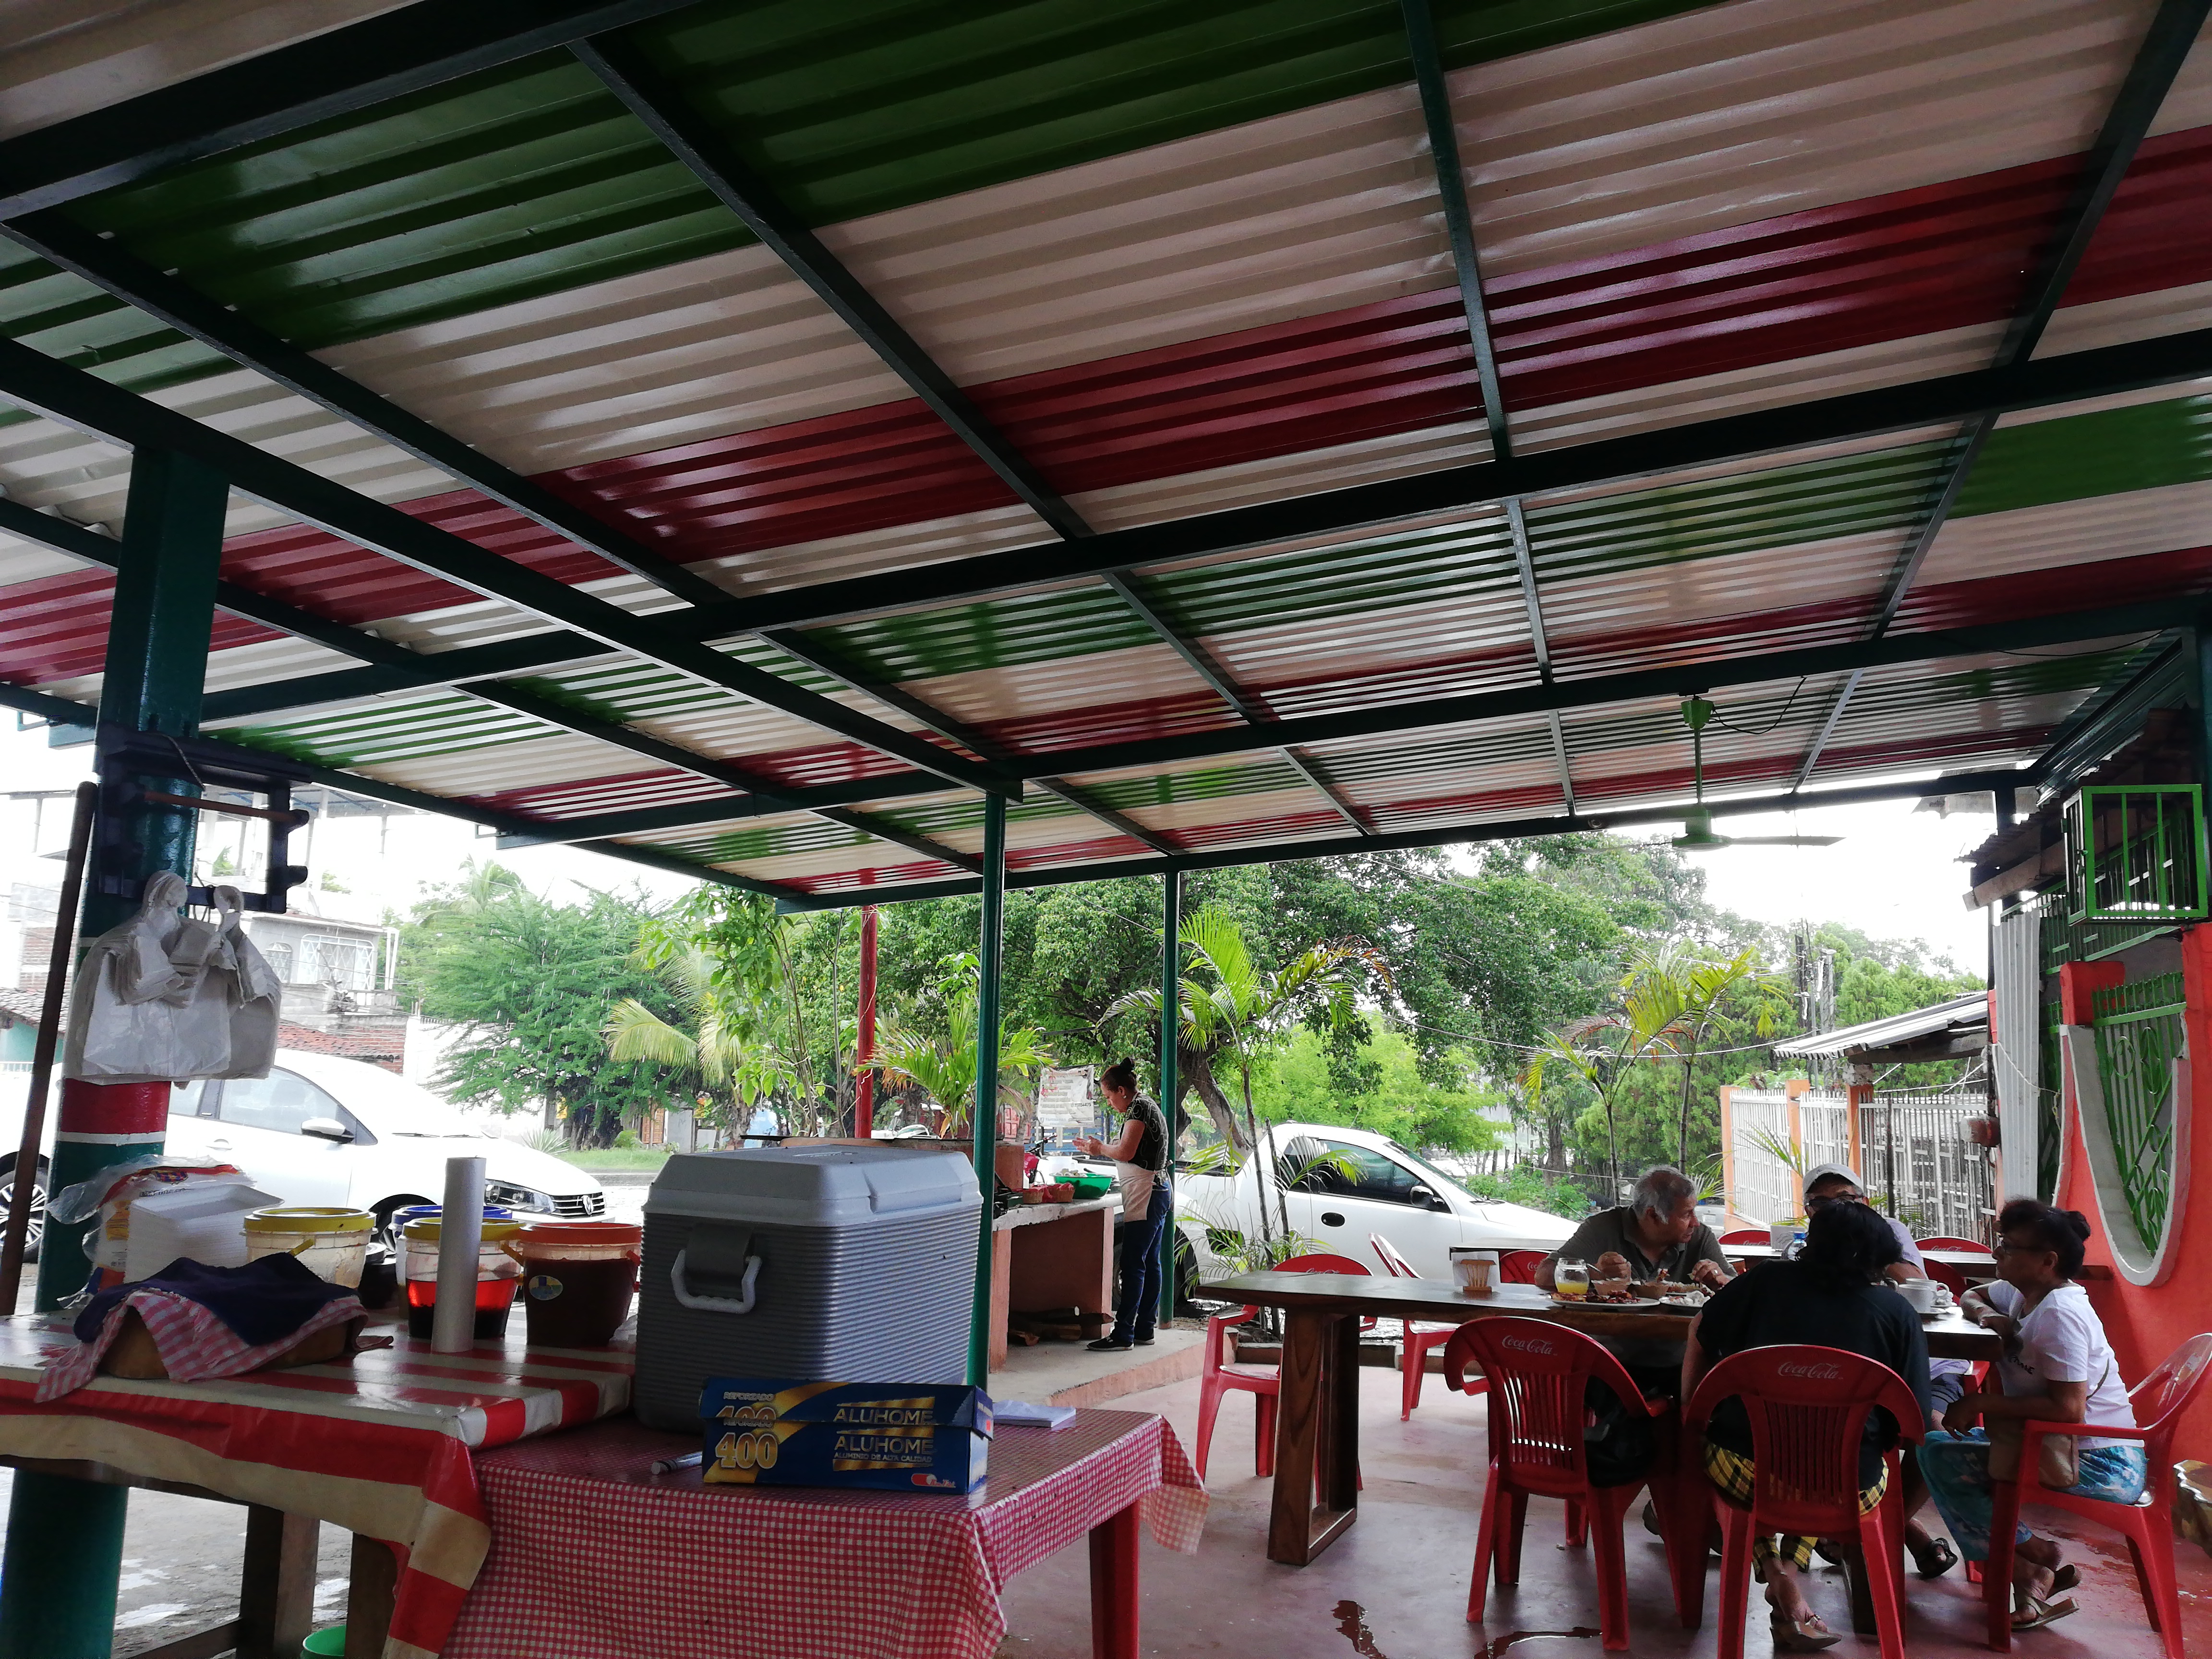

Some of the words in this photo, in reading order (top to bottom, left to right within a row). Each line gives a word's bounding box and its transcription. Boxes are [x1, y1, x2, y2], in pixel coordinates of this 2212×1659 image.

[723, 1392, 774, 1401] REFORZADO
[833, 1408, 933, 1425] ALUHOME
[715, 1432, 778, 1469] 400
[834, 1436, 934, 1455] ALUHOME
[834, 1452, 869, 1460] ALUMINIO
